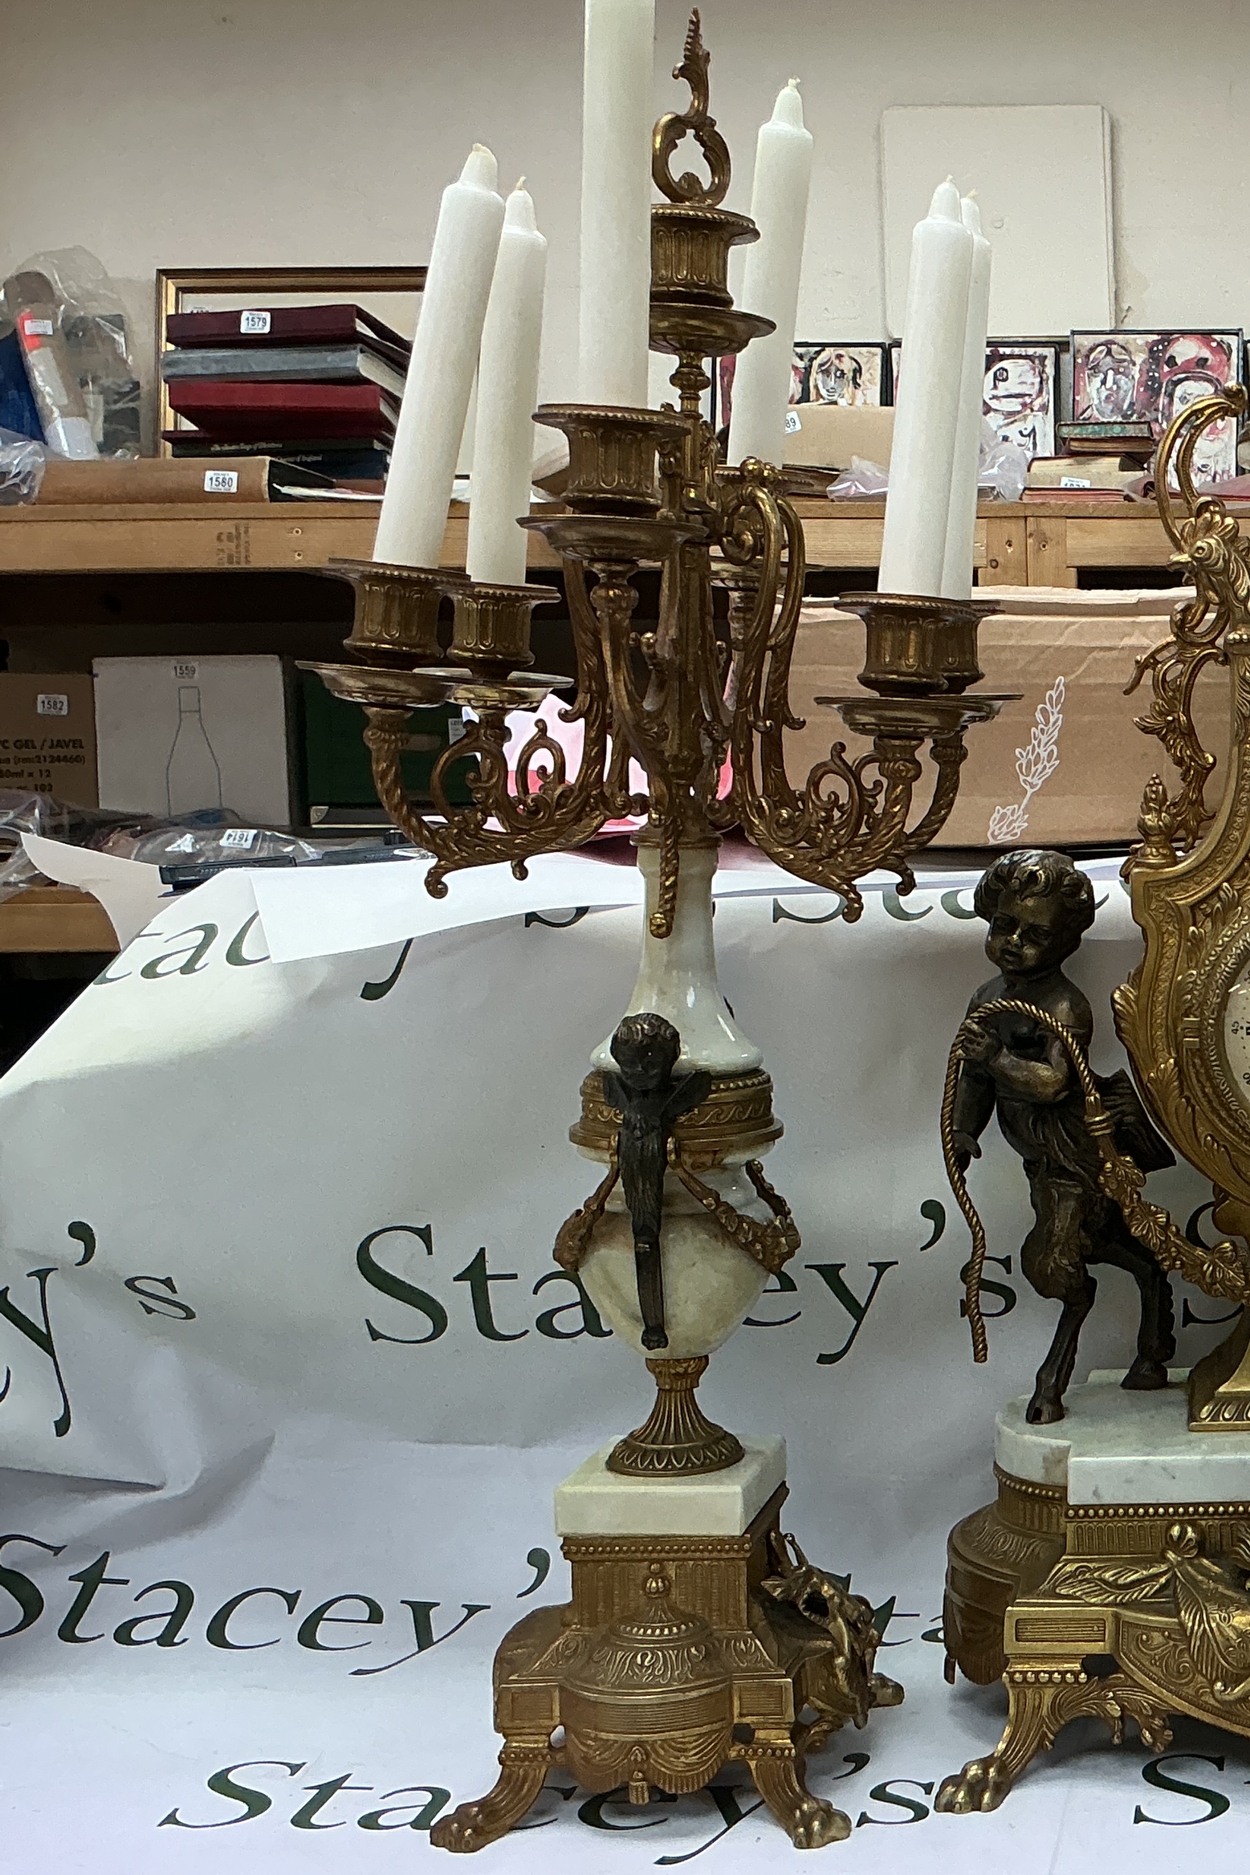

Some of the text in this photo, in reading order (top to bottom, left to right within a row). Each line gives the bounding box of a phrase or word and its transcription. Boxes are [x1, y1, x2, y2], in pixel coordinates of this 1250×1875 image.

[245, 316, 267, 328] 1579
[173, 665, 197, 677] 1559
[41, 700, 64, 711] 1582
[13, 739, 37, 750] GEL
[48, 739, 85, 750] JAVEL
[39, 769, 51, 779] 12
[356, 1198, 1018, 1365] Stay's
[0, 1533, 552, 1676] Stacey'
